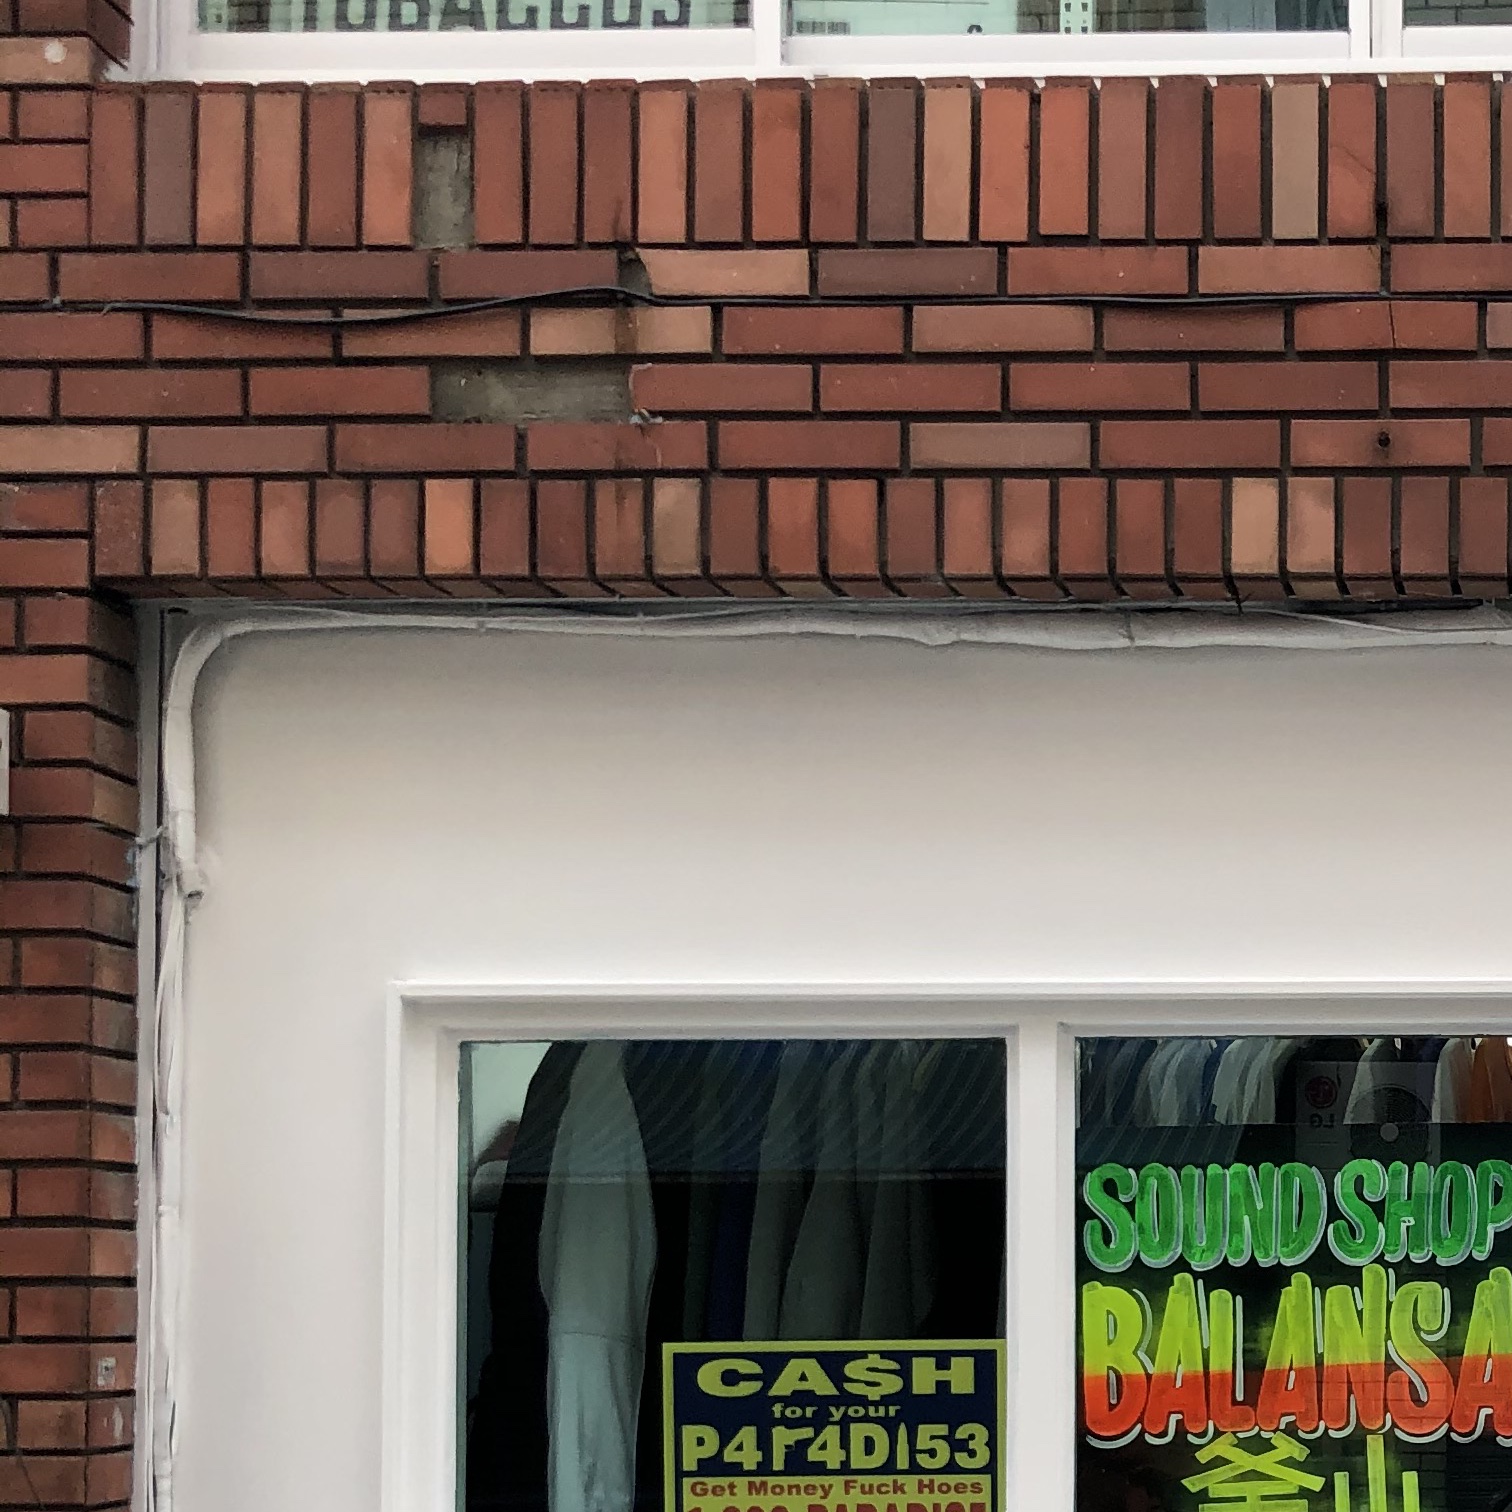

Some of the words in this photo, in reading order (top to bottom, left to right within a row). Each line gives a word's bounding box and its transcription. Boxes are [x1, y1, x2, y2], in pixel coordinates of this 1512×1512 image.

[1084, 1161, 1328, 1272] SOUND
[697, 1353, 975, 1401] CA$H
[772, 1402, 818, 1419] for
[828, 1404, 901, 1422] your
[690, 1481, 736, 1498] Get
[747, 1480, 833, 1500] Money
[844, 1479, 907, 1496] Fuck
[917, 1478, 984, 1495] Hoes
